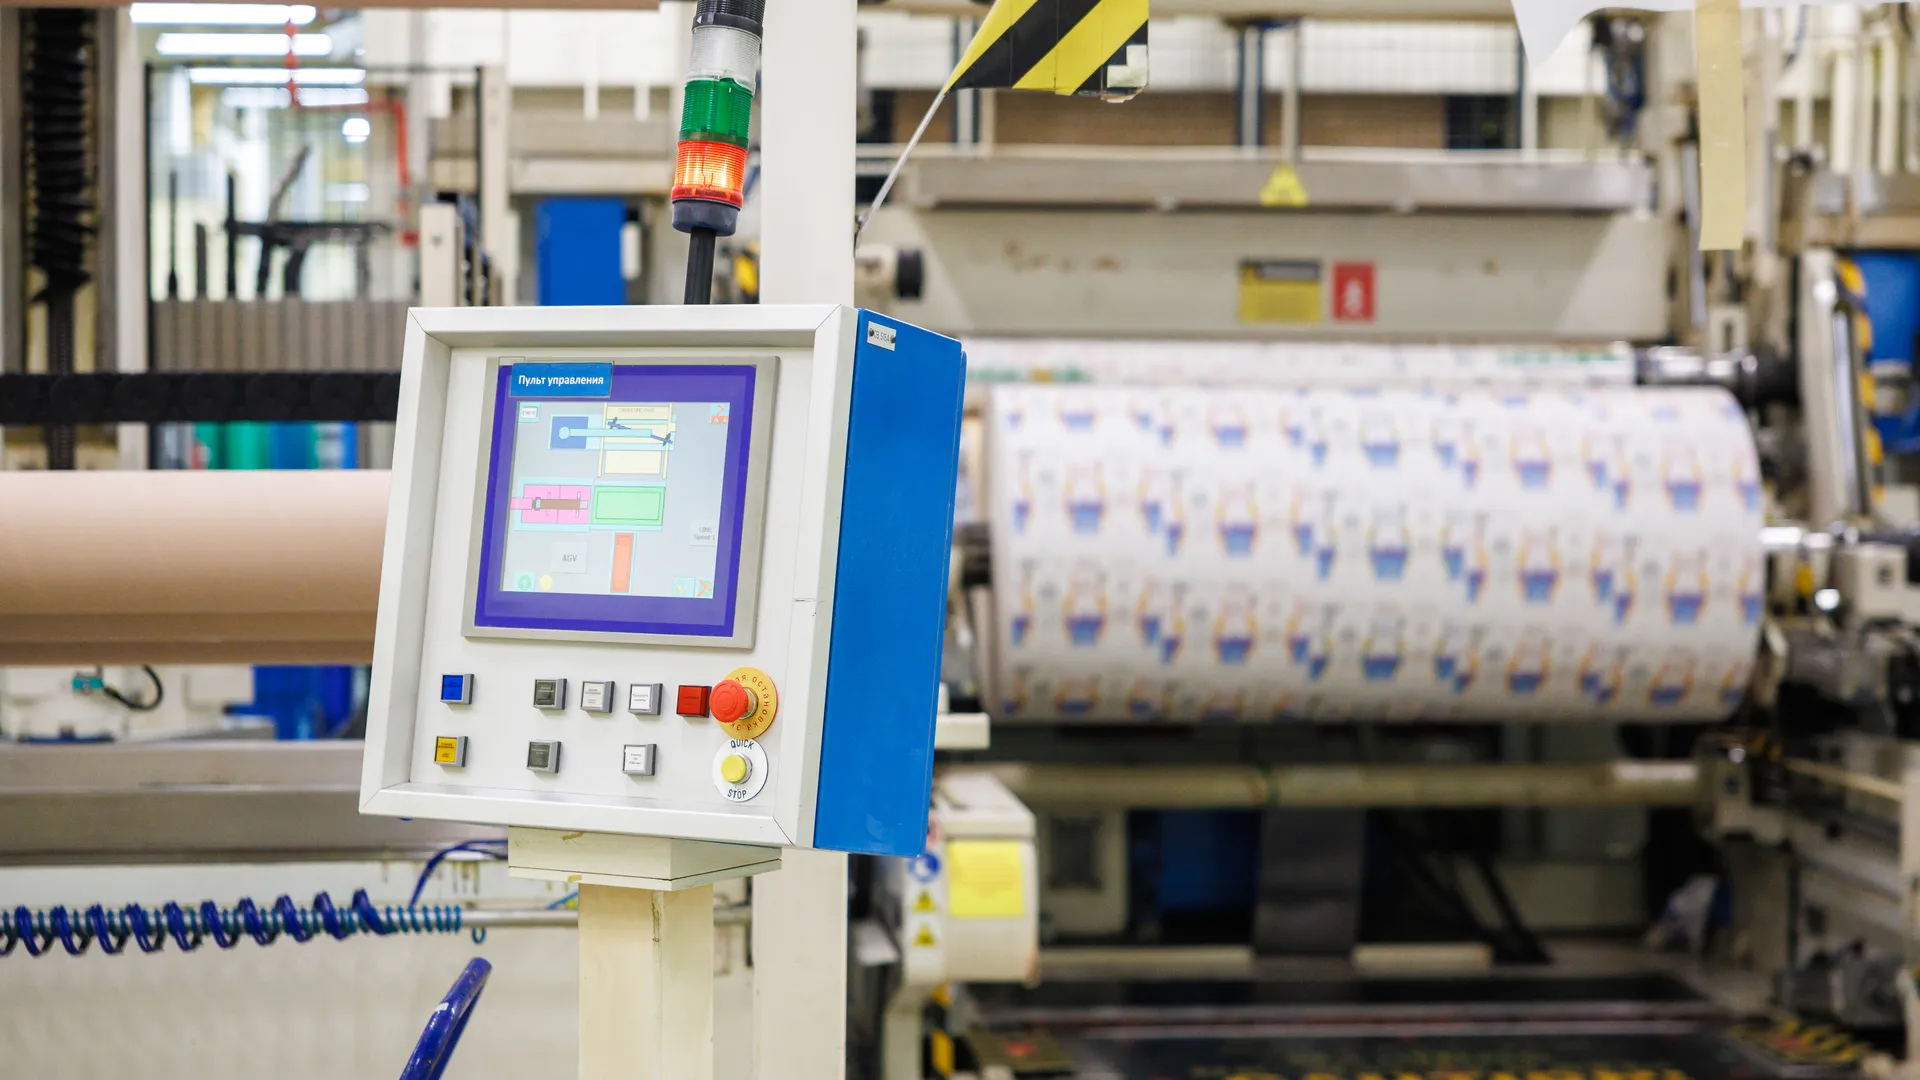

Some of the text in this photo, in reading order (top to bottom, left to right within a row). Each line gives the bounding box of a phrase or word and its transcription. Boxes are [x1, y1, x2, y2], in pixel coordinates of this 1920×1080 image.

[518, 375, 604, 387] Пульт управления
[561, 554, 578, 563] AGV
[730, 739, 754, 750] QUICK
[727, 788, 747, 800] STOP
